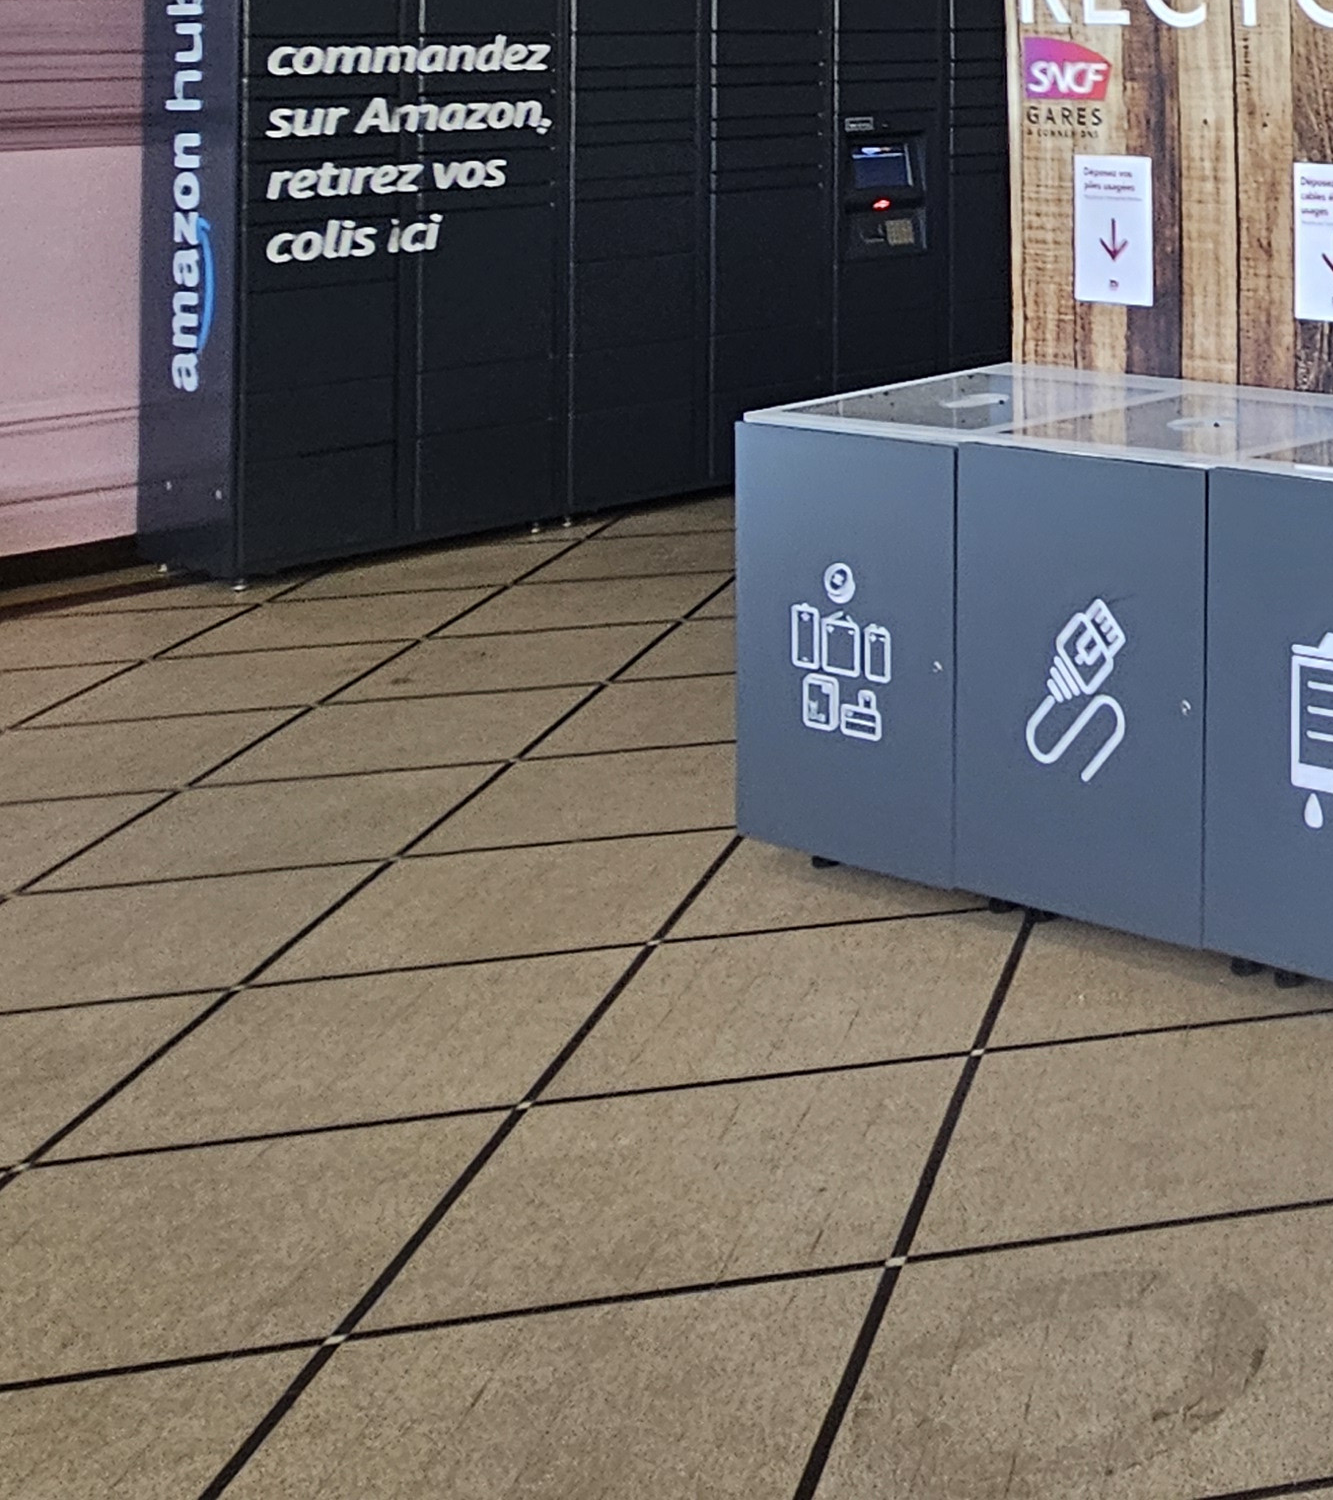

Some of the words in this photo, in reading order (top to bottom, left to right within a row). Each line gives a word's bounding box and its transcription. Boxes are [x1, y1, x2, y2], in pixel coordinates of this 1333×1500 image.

[267, 34, 551, 76] commandez
[1028, 61, 1108, 93] SNCF
[265, 107, 349, 138] sur
[1027, 105, 1102, 126] GARES
[266, 162, 424, 200] retirez
[432, 159, 507, 189] vos
[266, 219, 377, 263] colis
[388, 213, 443, 253] ici
[172, 132, 201, 391] amazon
